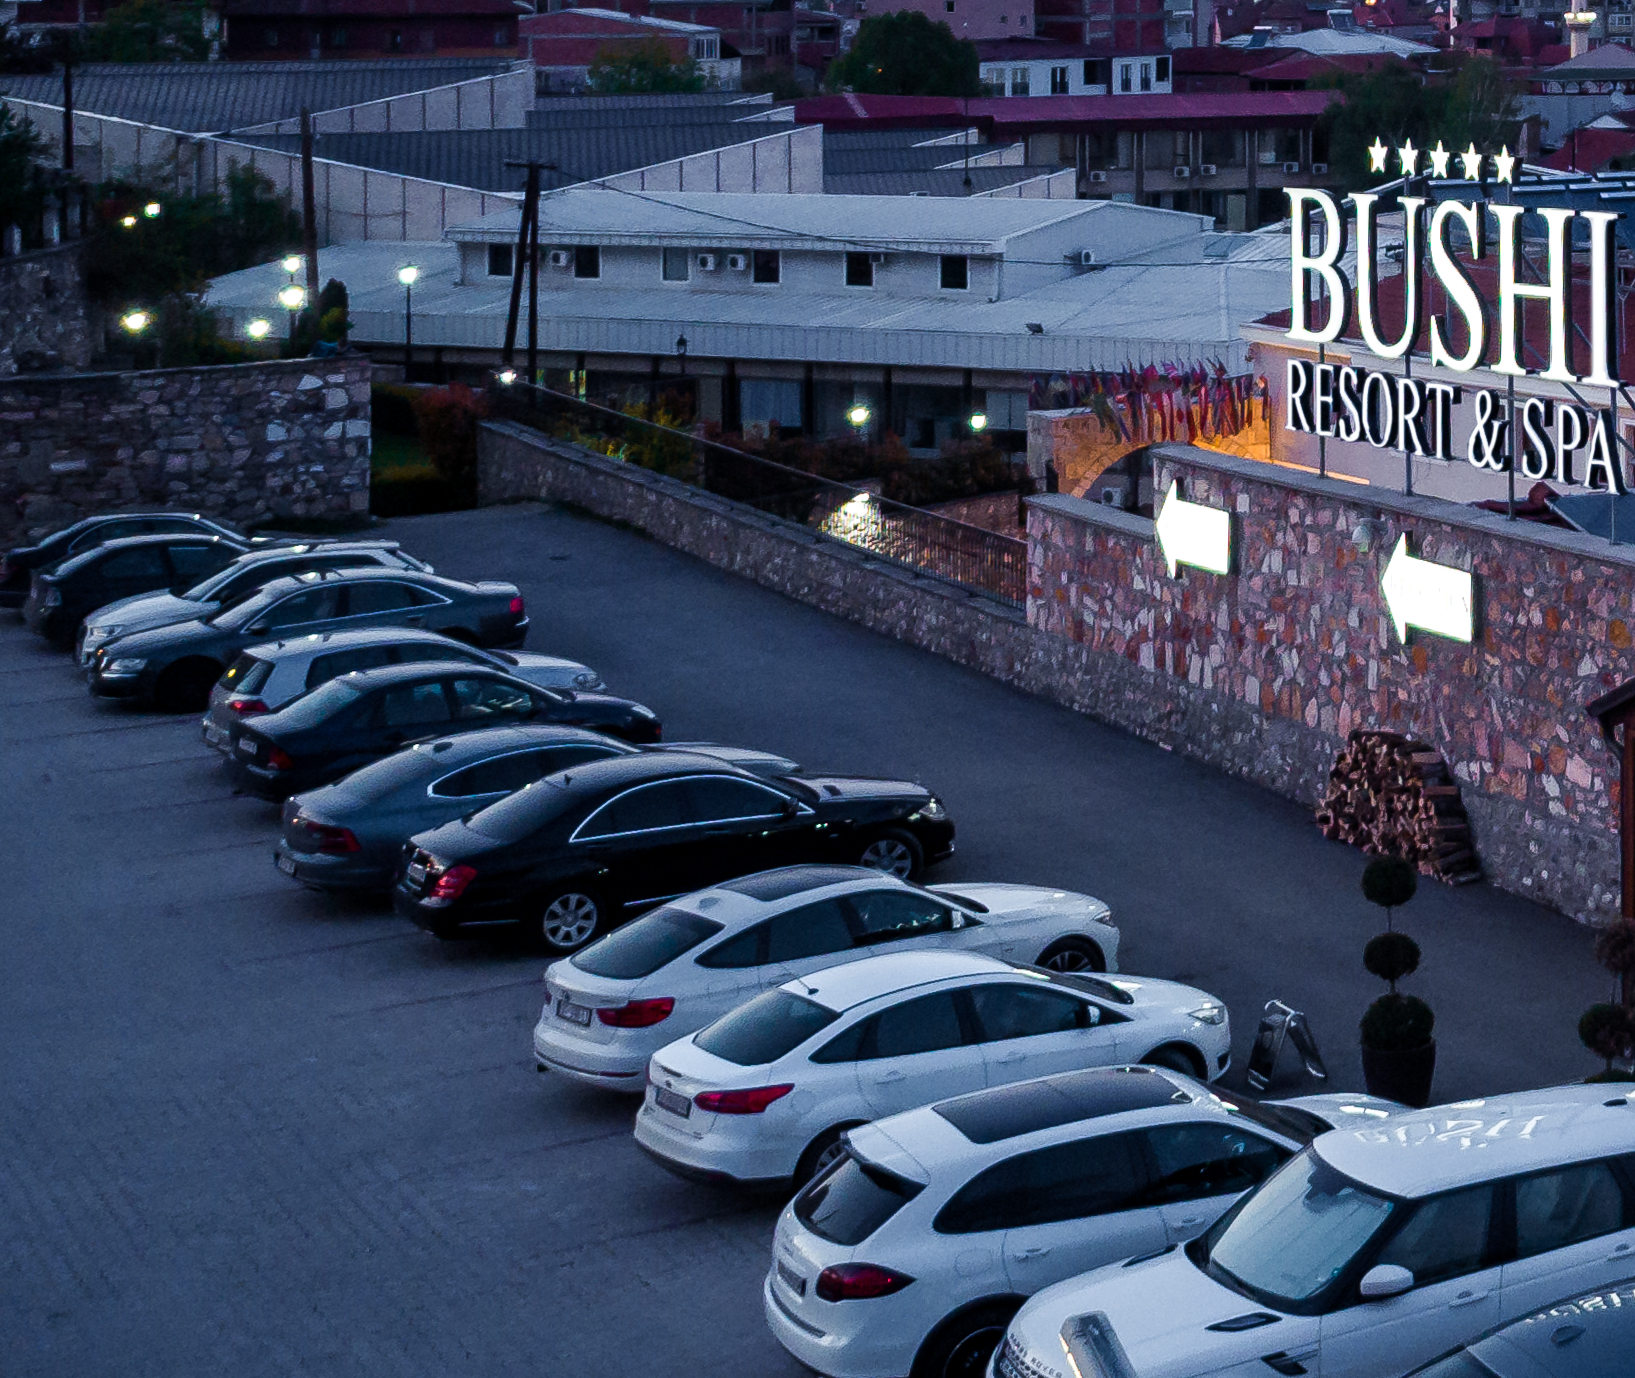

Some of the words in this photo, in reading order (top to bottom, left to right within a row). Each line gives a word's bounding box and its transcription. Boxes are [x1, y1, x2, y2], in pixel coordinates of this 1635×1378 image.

[1282, 186, 1624, 388] BUSHI
[1285, 358, 1457, 459] RESORT
[1467, 389, 1506, 472] &
[1522, 397, 1622, 496] SPA
